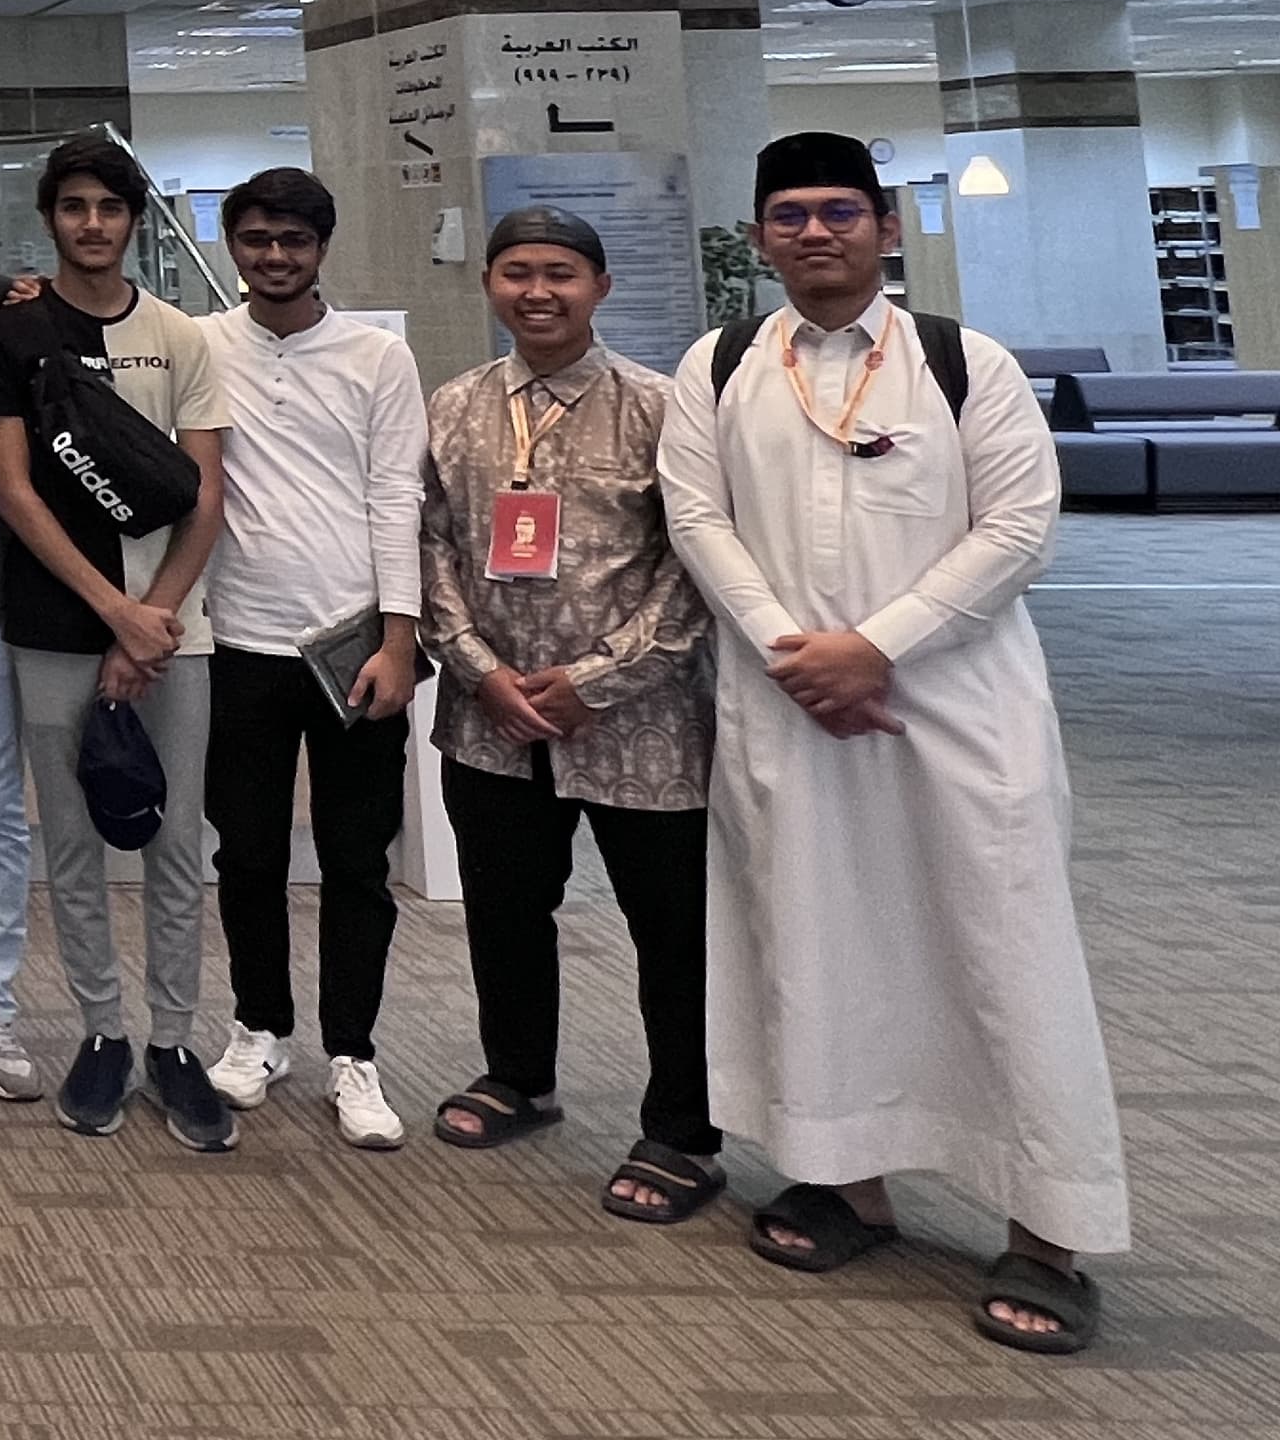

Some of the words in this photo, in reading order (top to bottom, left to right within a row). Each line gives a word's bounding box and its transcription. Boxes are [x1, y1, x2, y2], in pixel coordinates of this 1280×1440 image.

[501, 34, 571, 59] العربية
[577, 37, 638, 57] الكتب
[52, 431, 134, 522] adidas
